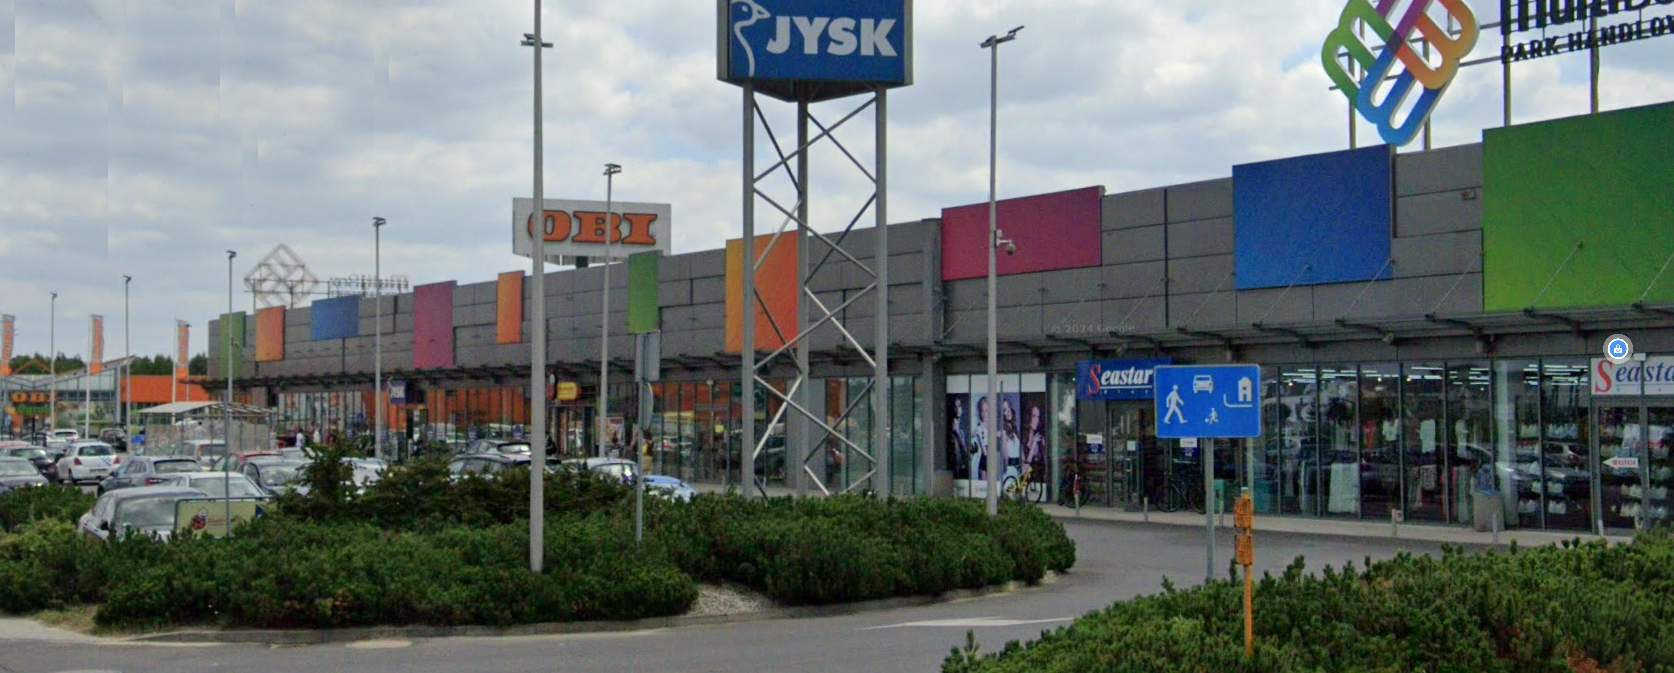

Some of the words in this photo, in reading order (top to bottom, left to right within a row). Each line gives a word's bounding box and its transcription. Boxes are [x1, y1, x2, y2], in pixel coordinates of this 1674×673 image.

[766, 16, 897, 57] JYSK
[1501, 36, 1560, 64] PARK
[528, 210, 658, 246] OBI
[1088, 364, 1153, 396] Seastar
